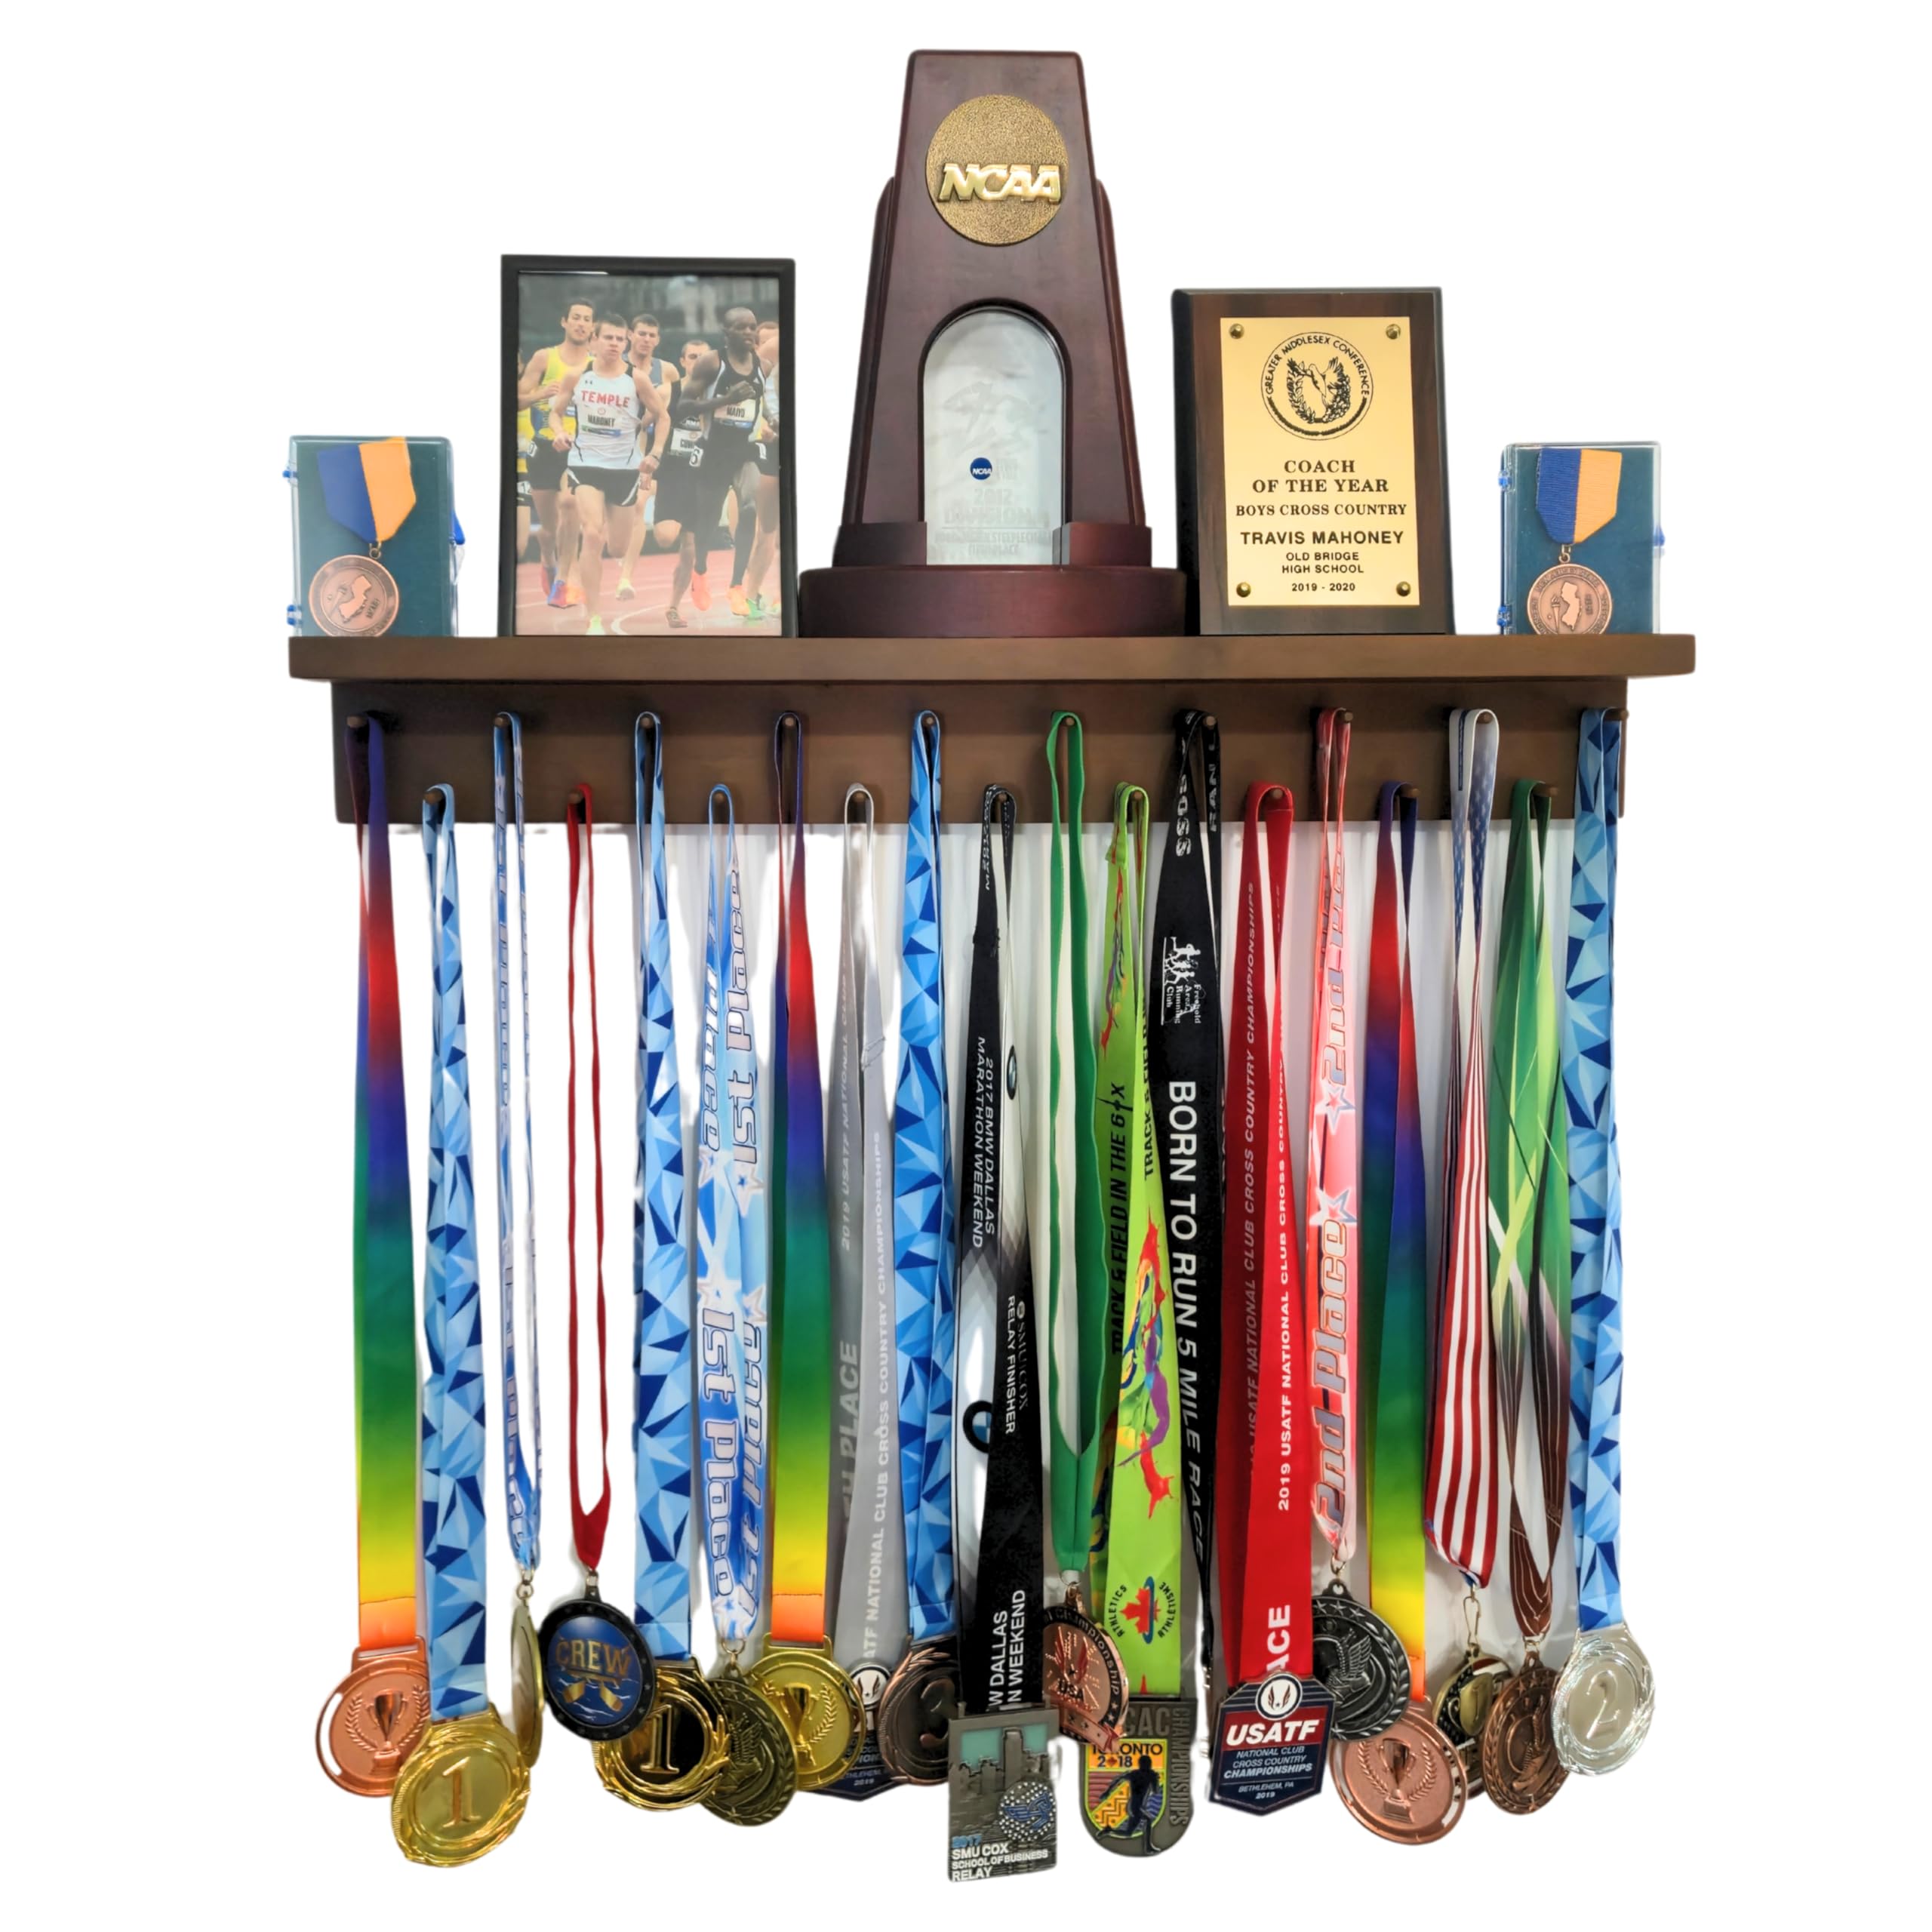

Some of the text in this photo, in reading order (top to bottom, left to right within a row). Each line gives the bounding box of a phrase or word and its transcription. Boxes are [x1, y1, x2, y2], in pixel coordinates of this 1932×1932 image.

[937, 163, 1061, 205] NCAA
[1265, 335, 1370, 395] GREATER MIDDLESEX CONFERENCE
[581, 390, 630, 408] TEMPLE
[1252, 479, 1389, 494] OF THE YEAR
[1284, 460, 1355, 473] COACH
[1235, 503, 1407, 516] BOYS CROSS COUNTRY
[1240, 531, 1404, 545] TRAVIS MAHONEY
[1285, 552, 1359, 561] OLD BRIDGE
[1281, 564, 1364, 574] HIGH SCHOOL
[1291, 583, 1318, 592] 2019
[1329, 583, 1355, 592] 2020
[726, 869, 752, 1051] Place
[1166, 986, 1174, 1008] Club
[1174, 985, 1183, 1024] Running
[1193, 983, 1201, 1024] Freehold
[1322, 968, 1346, 1086] 2nd
[1245, 1050, 1254, 1143] COUNTRY
[972, 1036, 986, 1247] MARATHON WEEKEND
[984, 1057, 995, 1235] 2017 BMW DALLAS
[1109, 1132, 1127, 1173] THE
[1143, 1108, 1155, 1180] TRACK
[1110, 1177, 1127, 1201] IN
[1245, 1149, 1254, 1214] CROSS
[874, 1131, 886, 1294] CHAMPIONSHIPS
[1110, 1213, 1127, 1269] FIELD
[1244, 1220, 1254, 1272] CLUB
[1279, 1232, 1289, 1285] CLUB
[878, 1301, 888, 1394] COUNTRY
[1169, 1081, 1204, 1564] BORN TO RUN 5 MILE RACE
[1245, 1280, 1259, 1373] NATIONAL
[1280, 1291, 1292, 1388] NATIONAL
[1005, 1295, 1016, 1434] RELAY FINISHER
[1313, 1219, 1346, 1524] 2nd Place
[702, 1307, 741, 1598] 1st Place
[878, 1400, 890, 1466] CROSS
[1280, 1394, 1292, 1457] USATF
[874, 1471, 889, 1522] CLUB
[1278, 1463, 1291, 1511] 2019
[866, 1526, 884, 1621] NATIONAL
[1109, 1584, 1127, 1637] ATHLETICS
[1158, 1581, 1176, 1638] ATHLETISME
[555, 1638, 632, 1676] CREW
[989, 1610, 1008, 1687] DALLAS
[1008, 1590, 1026, 1687] WEEKEND
[1586, 1669, 1621, 1740] 2
[640, 1704, 679, 1774] 1
[1226, 1719, 1320, 1746] USATF
[1236, 1745, 1305, 1758] NATIONAL CLUB
[1171, 1708, 1190, 1826] CHAMPIONSHIPS
[1223, 1763, 1312, 1779] CHAMPIONSHIPS
[1232, 1755, 1307, 1769] CROSS COUNTRY
[442, 1756, 481, 1828] 1
[952, 1842, 1009, 1860] SMU COX
[952, 1850, 1049, 1870] SCHOOL OF BUSINESS
[952, 1866, 992, 1882] RELAY
